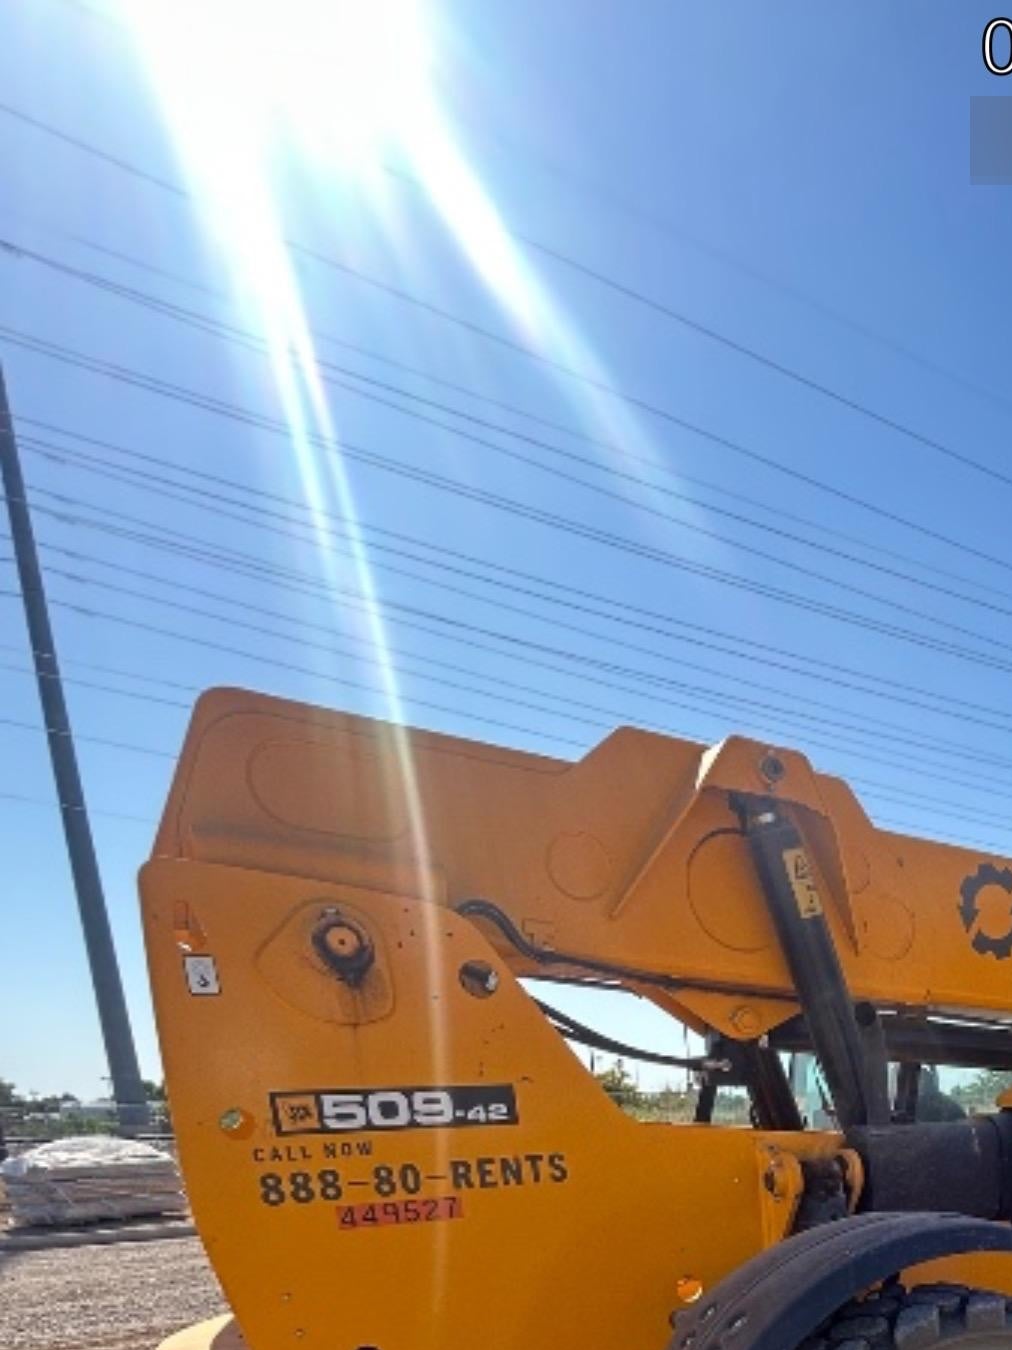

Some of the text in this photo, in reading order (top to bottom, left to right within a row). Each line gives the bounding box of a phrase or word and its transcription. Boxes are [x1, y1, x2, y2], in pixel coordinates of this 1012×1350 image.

[320, 1090, 510, 1128] 509-42
[253, 1140, 374, 1162] CALL NOW
[259, 1152, 569, 1207] 888-80-RENTS
[340, 1196, 459, 1228] 449527
